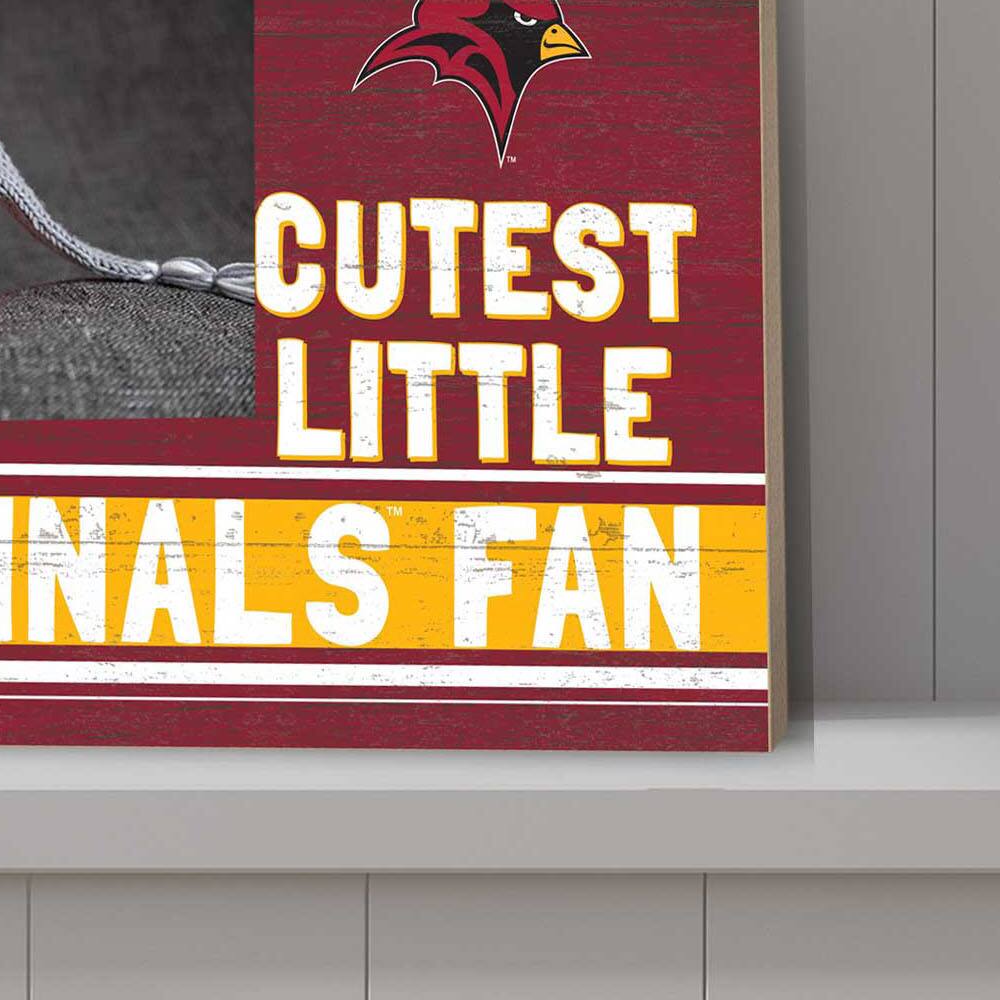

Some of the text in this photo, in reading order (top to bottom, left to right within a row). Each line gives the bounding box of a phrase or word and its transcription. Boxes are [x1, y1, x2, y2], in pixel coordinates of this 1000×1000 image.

[255, 191, 697, 322] CUTEST
[277, 338, 672, 466] LITTLE
[453, 505, 700, 651] FAN
